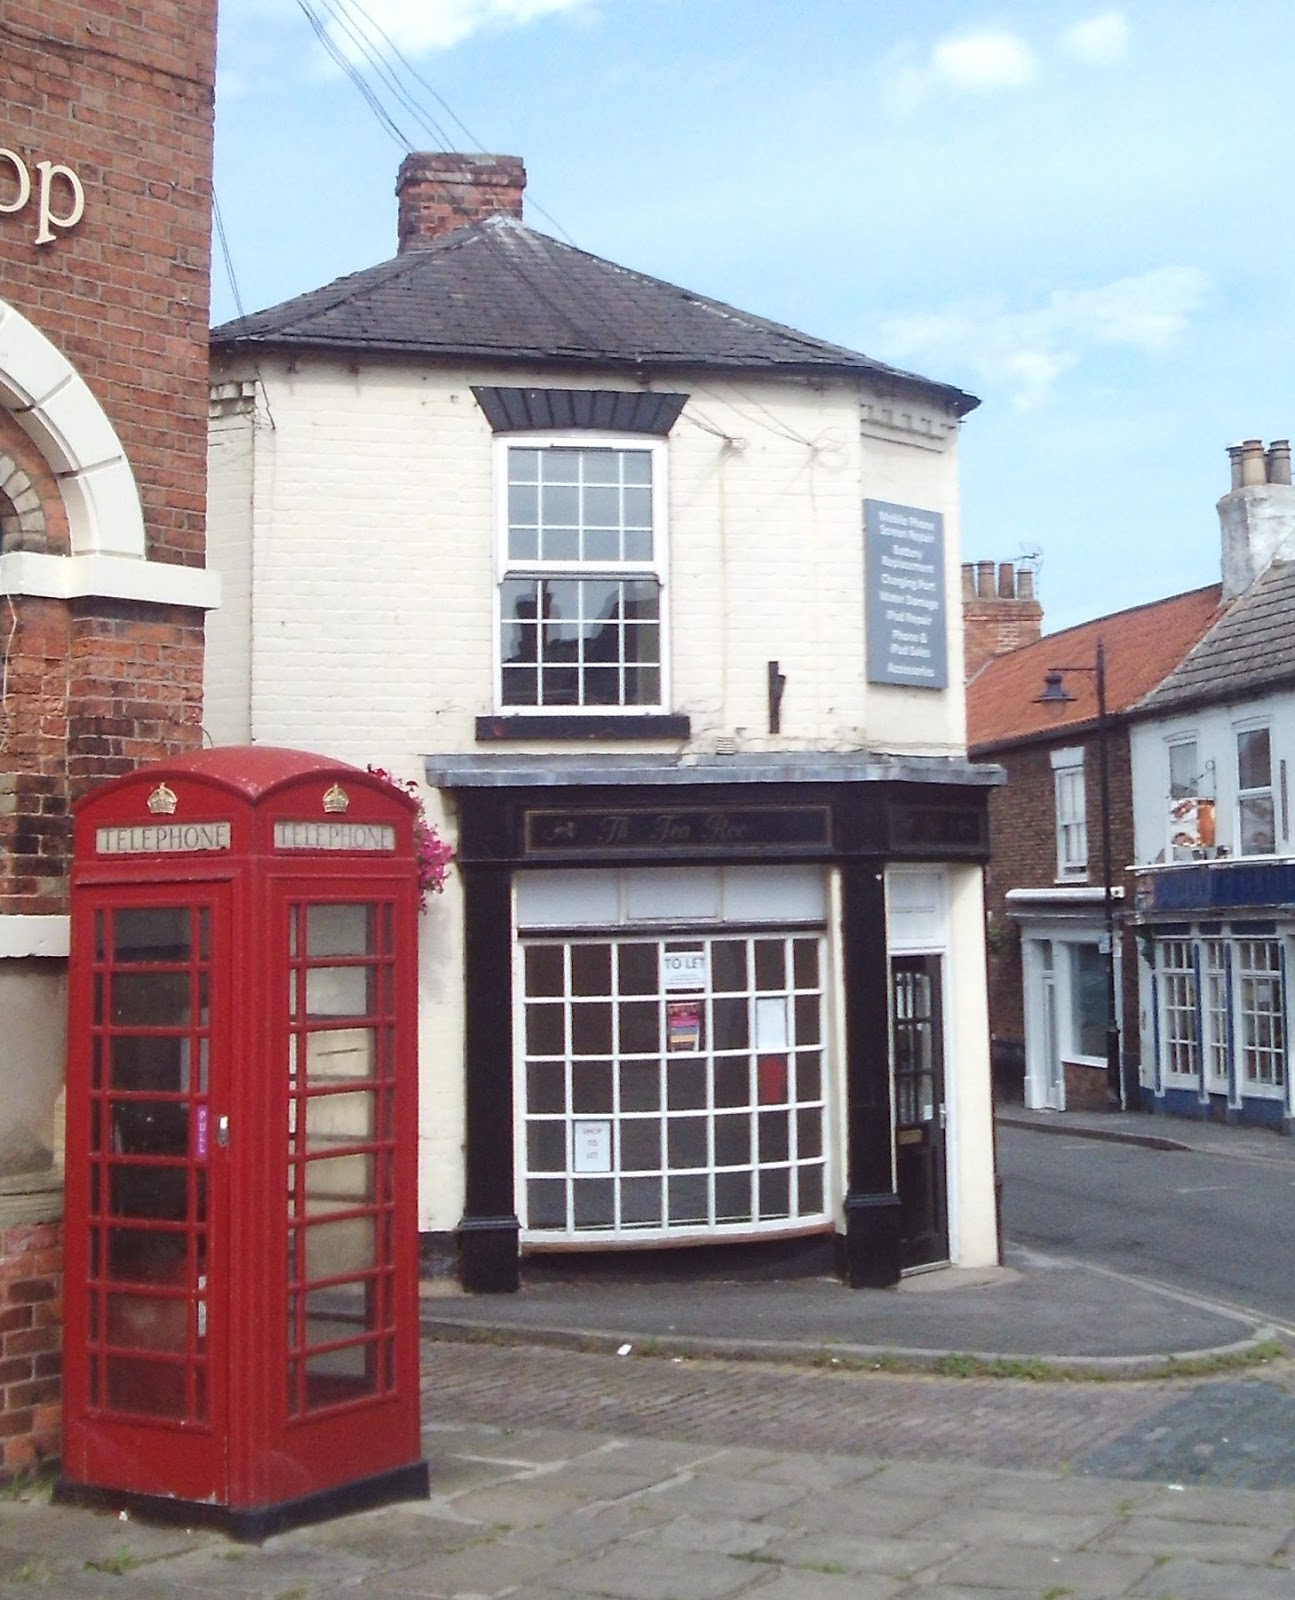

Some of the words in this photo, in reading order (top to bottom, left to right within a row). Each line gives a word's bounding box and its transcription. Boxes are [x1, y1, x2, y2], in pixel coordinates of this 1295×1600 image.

[103, 824, 227, 852] TELEPHONE
[280, 823, 391, 849] TELEPHONE
[664, 957, 682, 970] TO
[685, 956, 705, 969] LET
